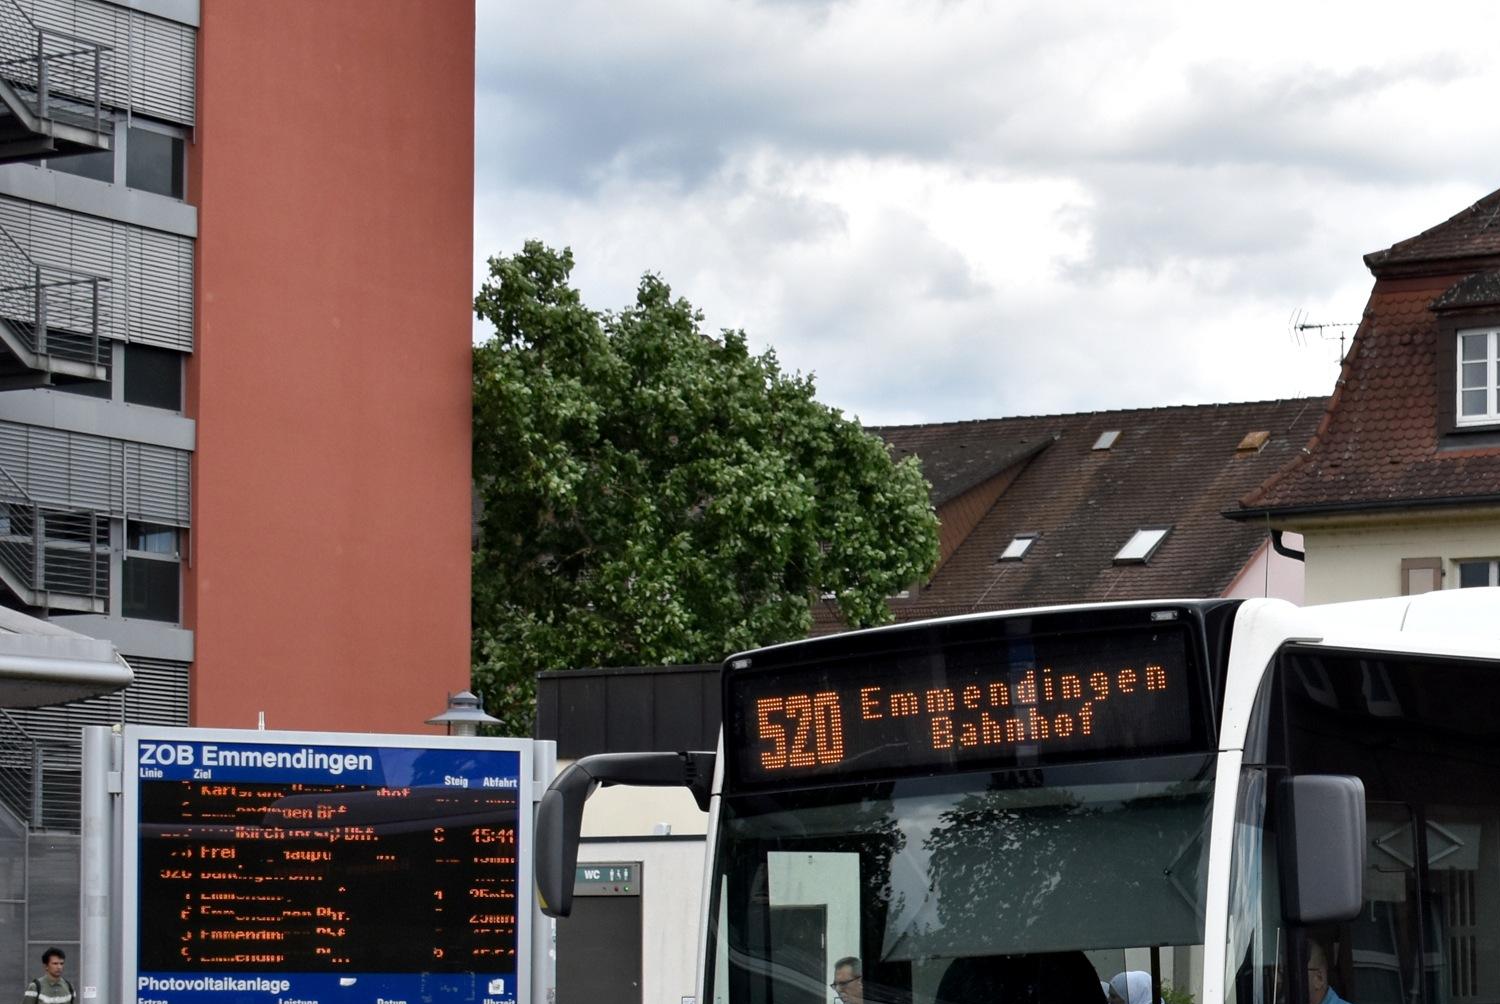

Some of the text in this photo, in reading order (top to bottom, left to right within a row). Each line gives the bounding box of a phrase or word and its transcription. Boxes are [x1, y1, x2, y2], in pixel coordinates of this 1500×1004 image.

[860, 664, 1167, 721] Emmendingen
[757, 691, 844, 770] 520
[932, 701, 1094, 750] Bahnhof
[139, 744, 373, 775] ZOB Emmendingen
[139, 767, 518, 788] Linie Ziel Steig Abfahrt
[584, 869, 601, 880] WC
[138, 977, 290, 995] Photovoltaikanlage
